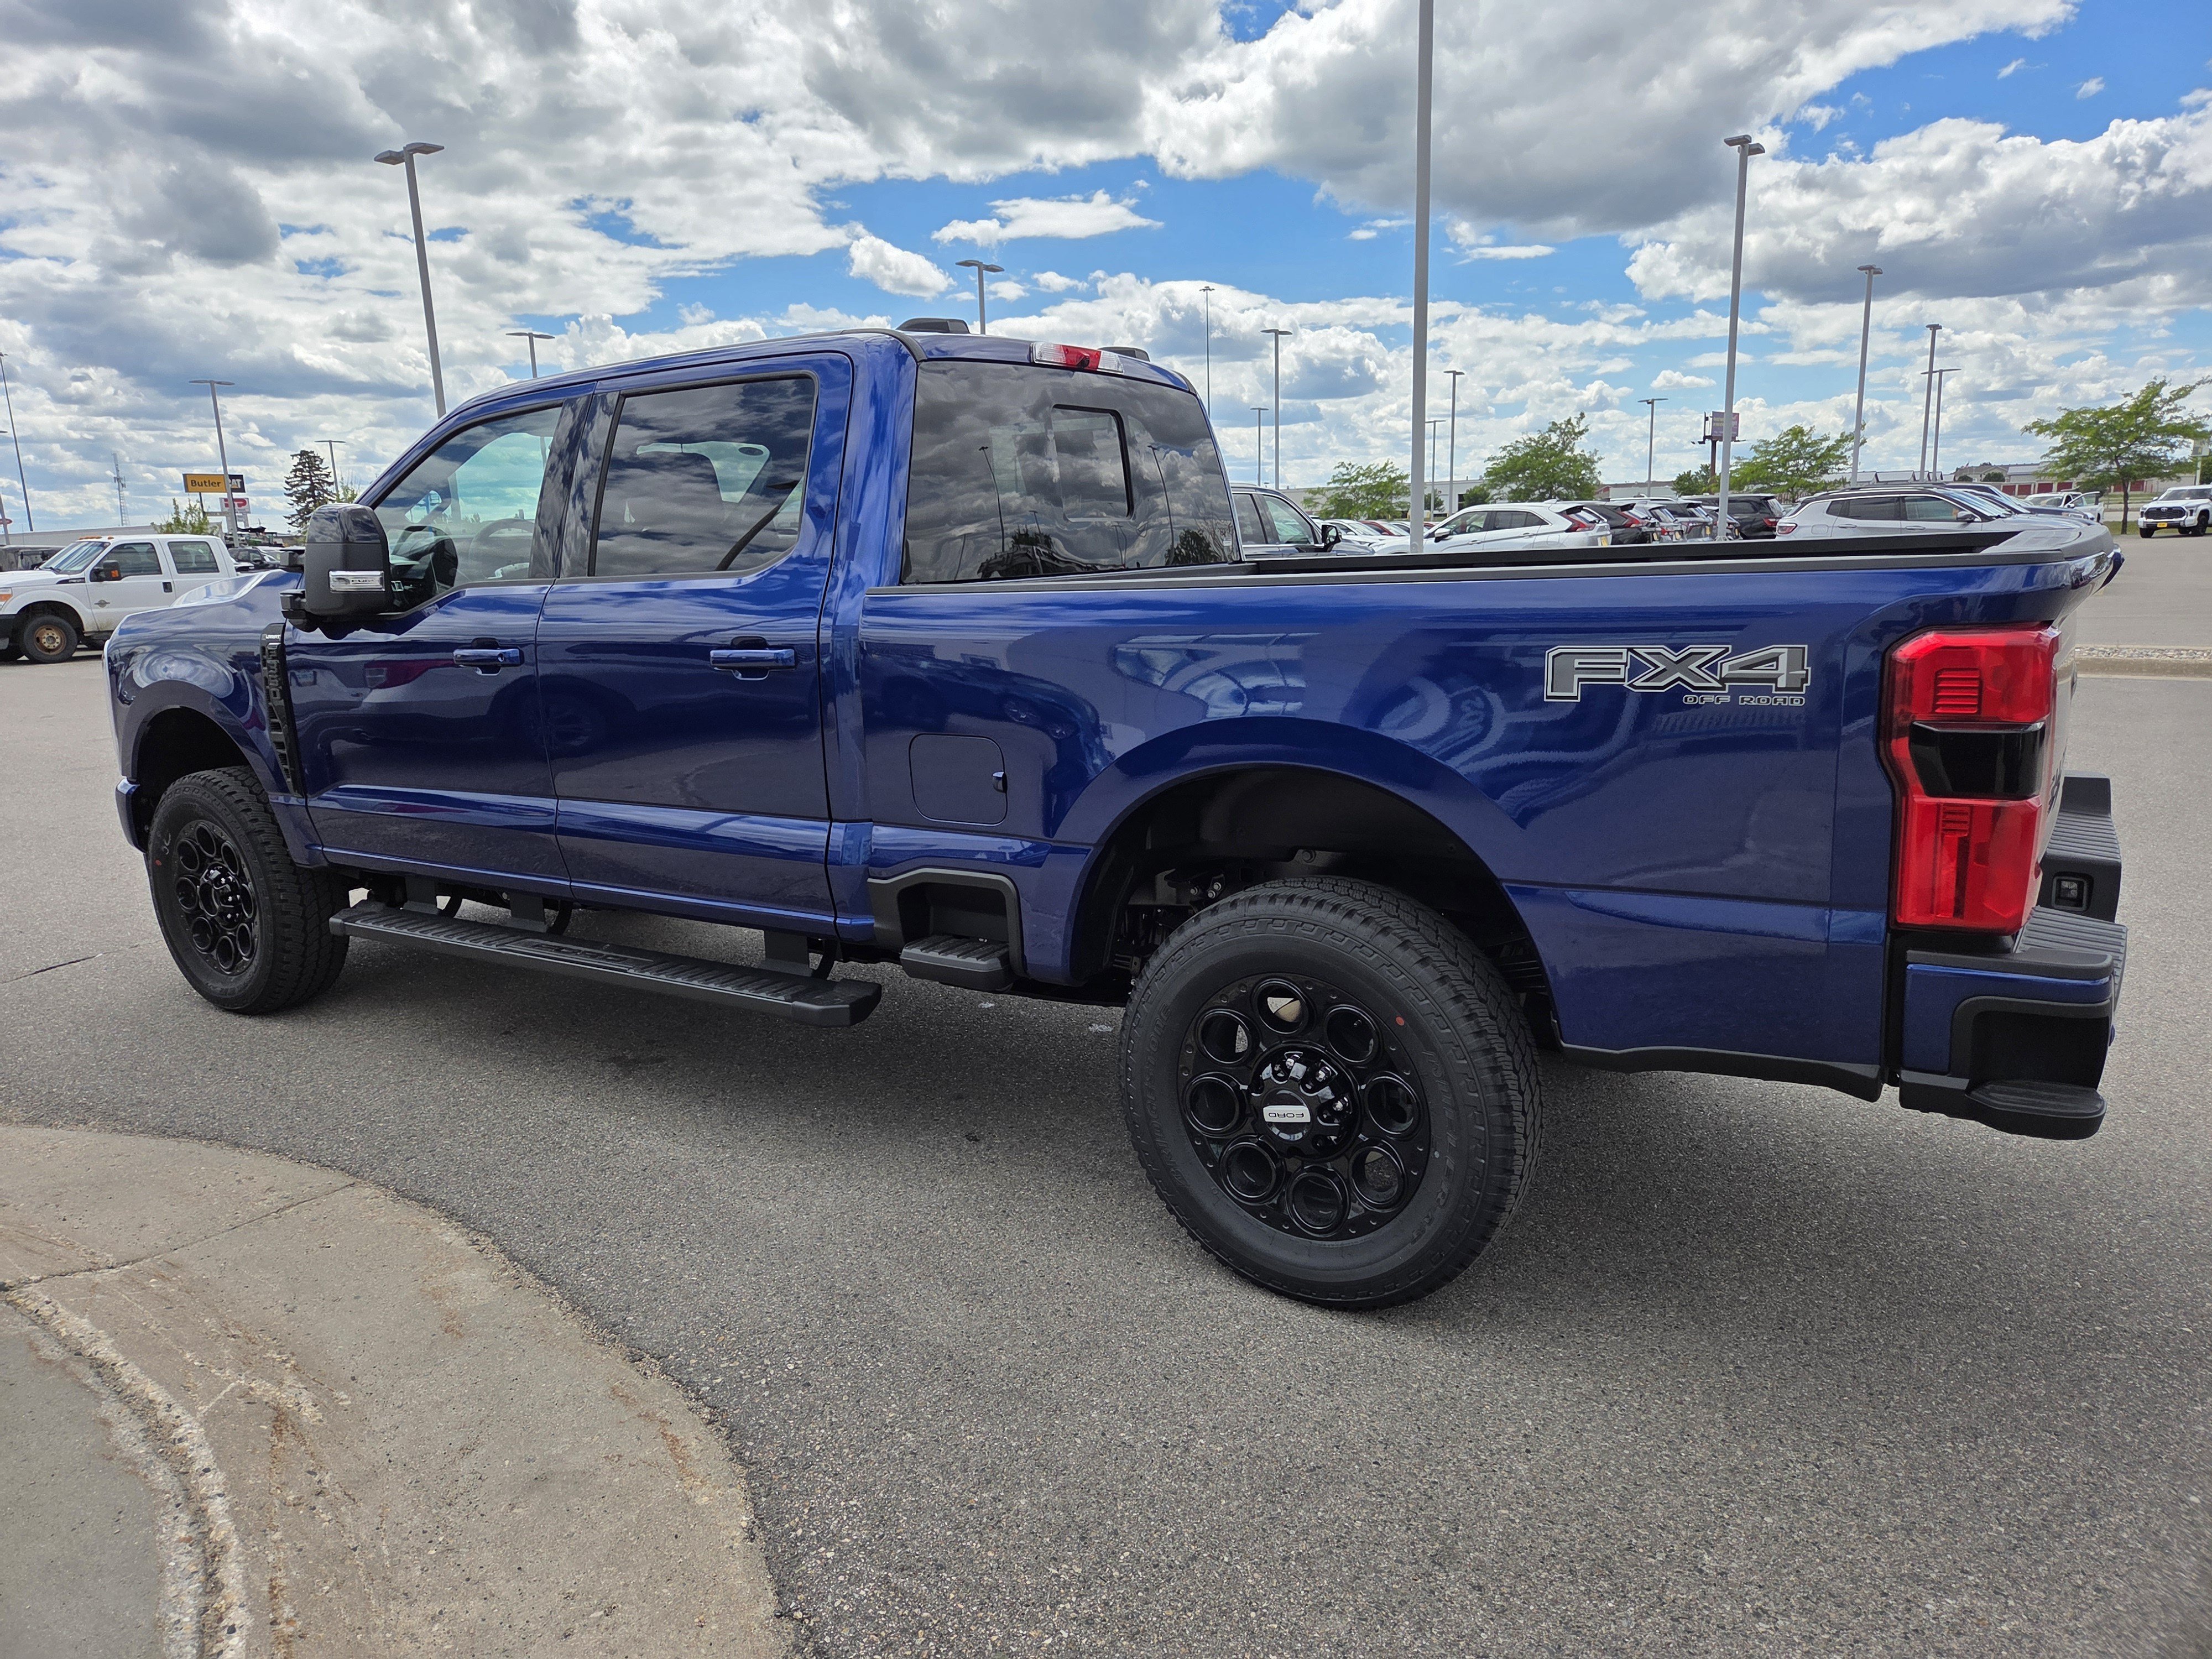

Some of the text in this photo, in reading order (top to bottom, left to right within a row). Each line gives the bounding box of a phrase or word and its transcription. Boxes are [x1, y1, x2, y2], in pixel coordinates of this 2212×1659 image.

[1544, 645, 1811, 702] FX4
[1683, 695, 1805, 706] OFF ROAD
[1144, 1000, 1188, 1185] BRIDGESTONE
